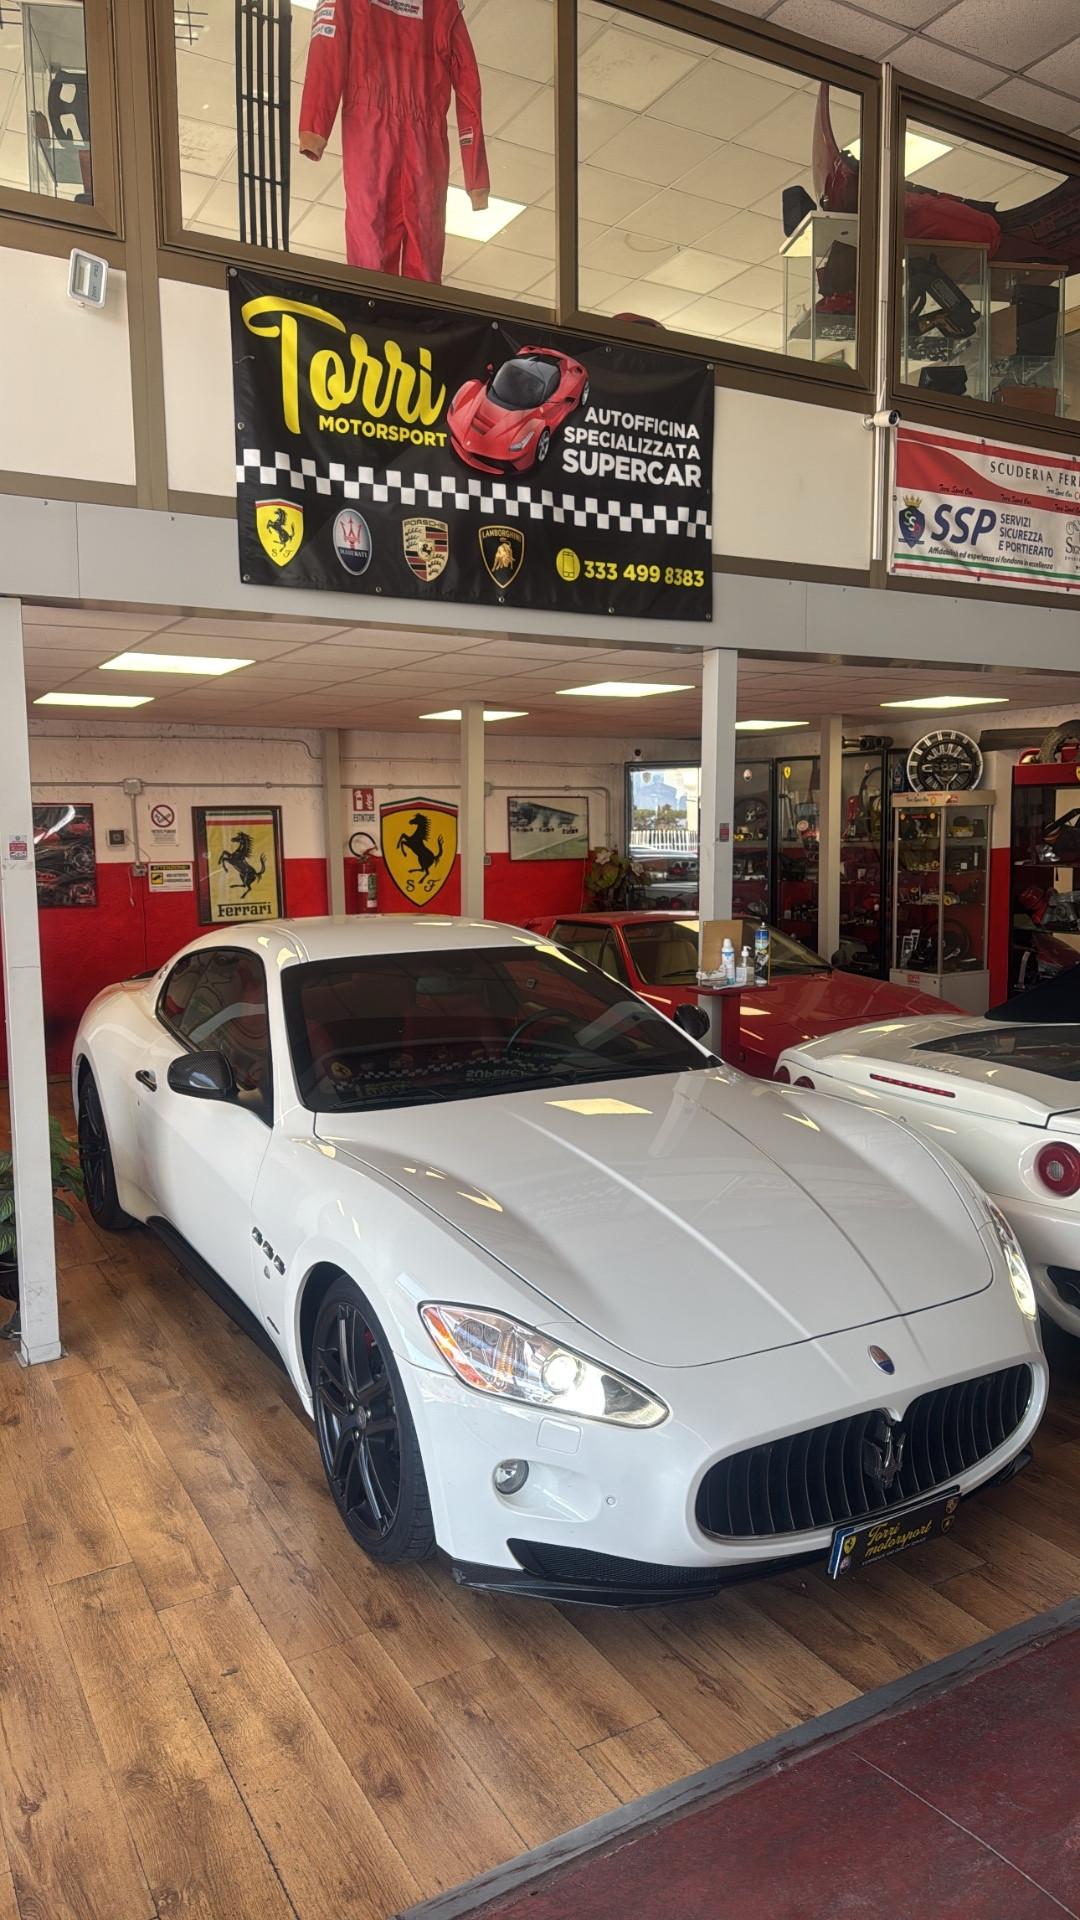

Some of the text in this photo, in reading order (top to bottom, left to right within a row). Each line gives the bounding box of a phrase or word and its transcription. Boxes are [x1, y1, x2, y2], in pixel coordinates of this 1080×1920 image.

[241, 296, 446, 434] Torri
[319, 415, 447, 447] MOTORSPORT
[584, 406, 701, 440] AUTOFFICINA
[563, 426, 701, 460] SPECIALIZZATA
[562, 448, 702, 488] SUPERCAR
[990, 461, 1054, 482] SCUDERIA
[404, 519, 446, 530] PORSCHE
[930, 503, 997, 546] SSP
[1000, 513, 1031, 528] SERVIZI
[482, 529, 522, 541] LAMBORGHINI
[999, 527, 1044, 543] SICUREZZA
[967, 553, 995, 562] esperienza
[998, 540, 1004, 550] E
[1005, 541, 1054, 558] PORTIERATO
[584, 560, 705, 587] 333 499 8383
[406, 879, 441, 892] S F
[217, 901, 272, 918] Ferrari
